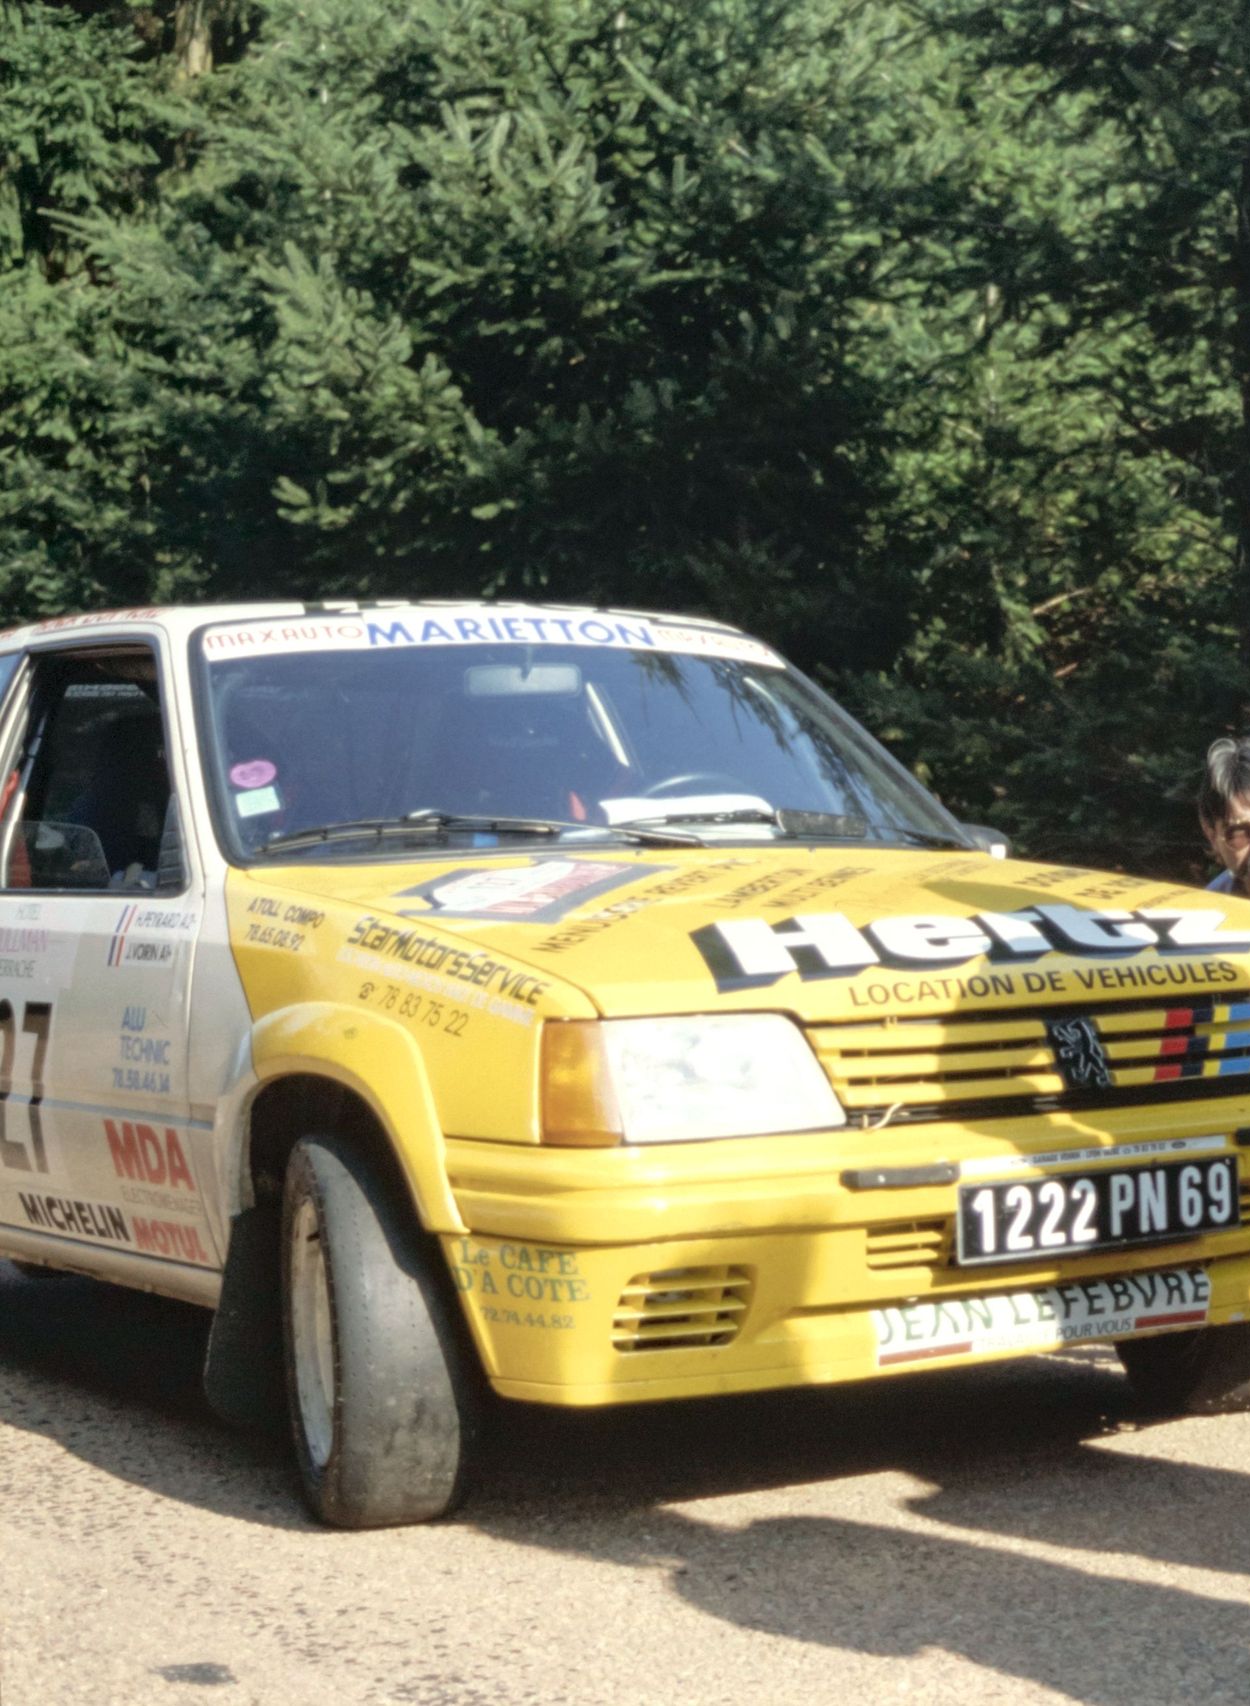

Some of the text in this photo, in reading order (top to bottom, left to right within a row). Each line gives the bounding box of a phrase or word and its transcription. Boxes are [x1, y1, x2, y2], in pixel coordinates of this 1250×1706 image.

[367, 617, 656, 646] MARIETTON
[848, 961, 1238, 1006] LOCATION DE VEHICULES
[443, 1009, 469, 1037] 22
[104, 1119, 196, 1191] MDA
[18, 1192, 131, 1242] MICHELIN
[972, 1162, 1232, 1253] 1222 PN 69
[131, 1216, 209, 1262] MOTUL
[880, 1269, 1209, 1346] JEAN LEFEBVRE
[1056, 1322, 1092, 1340] POUR
[1097, 1318, 1133, 1335] VOUS
